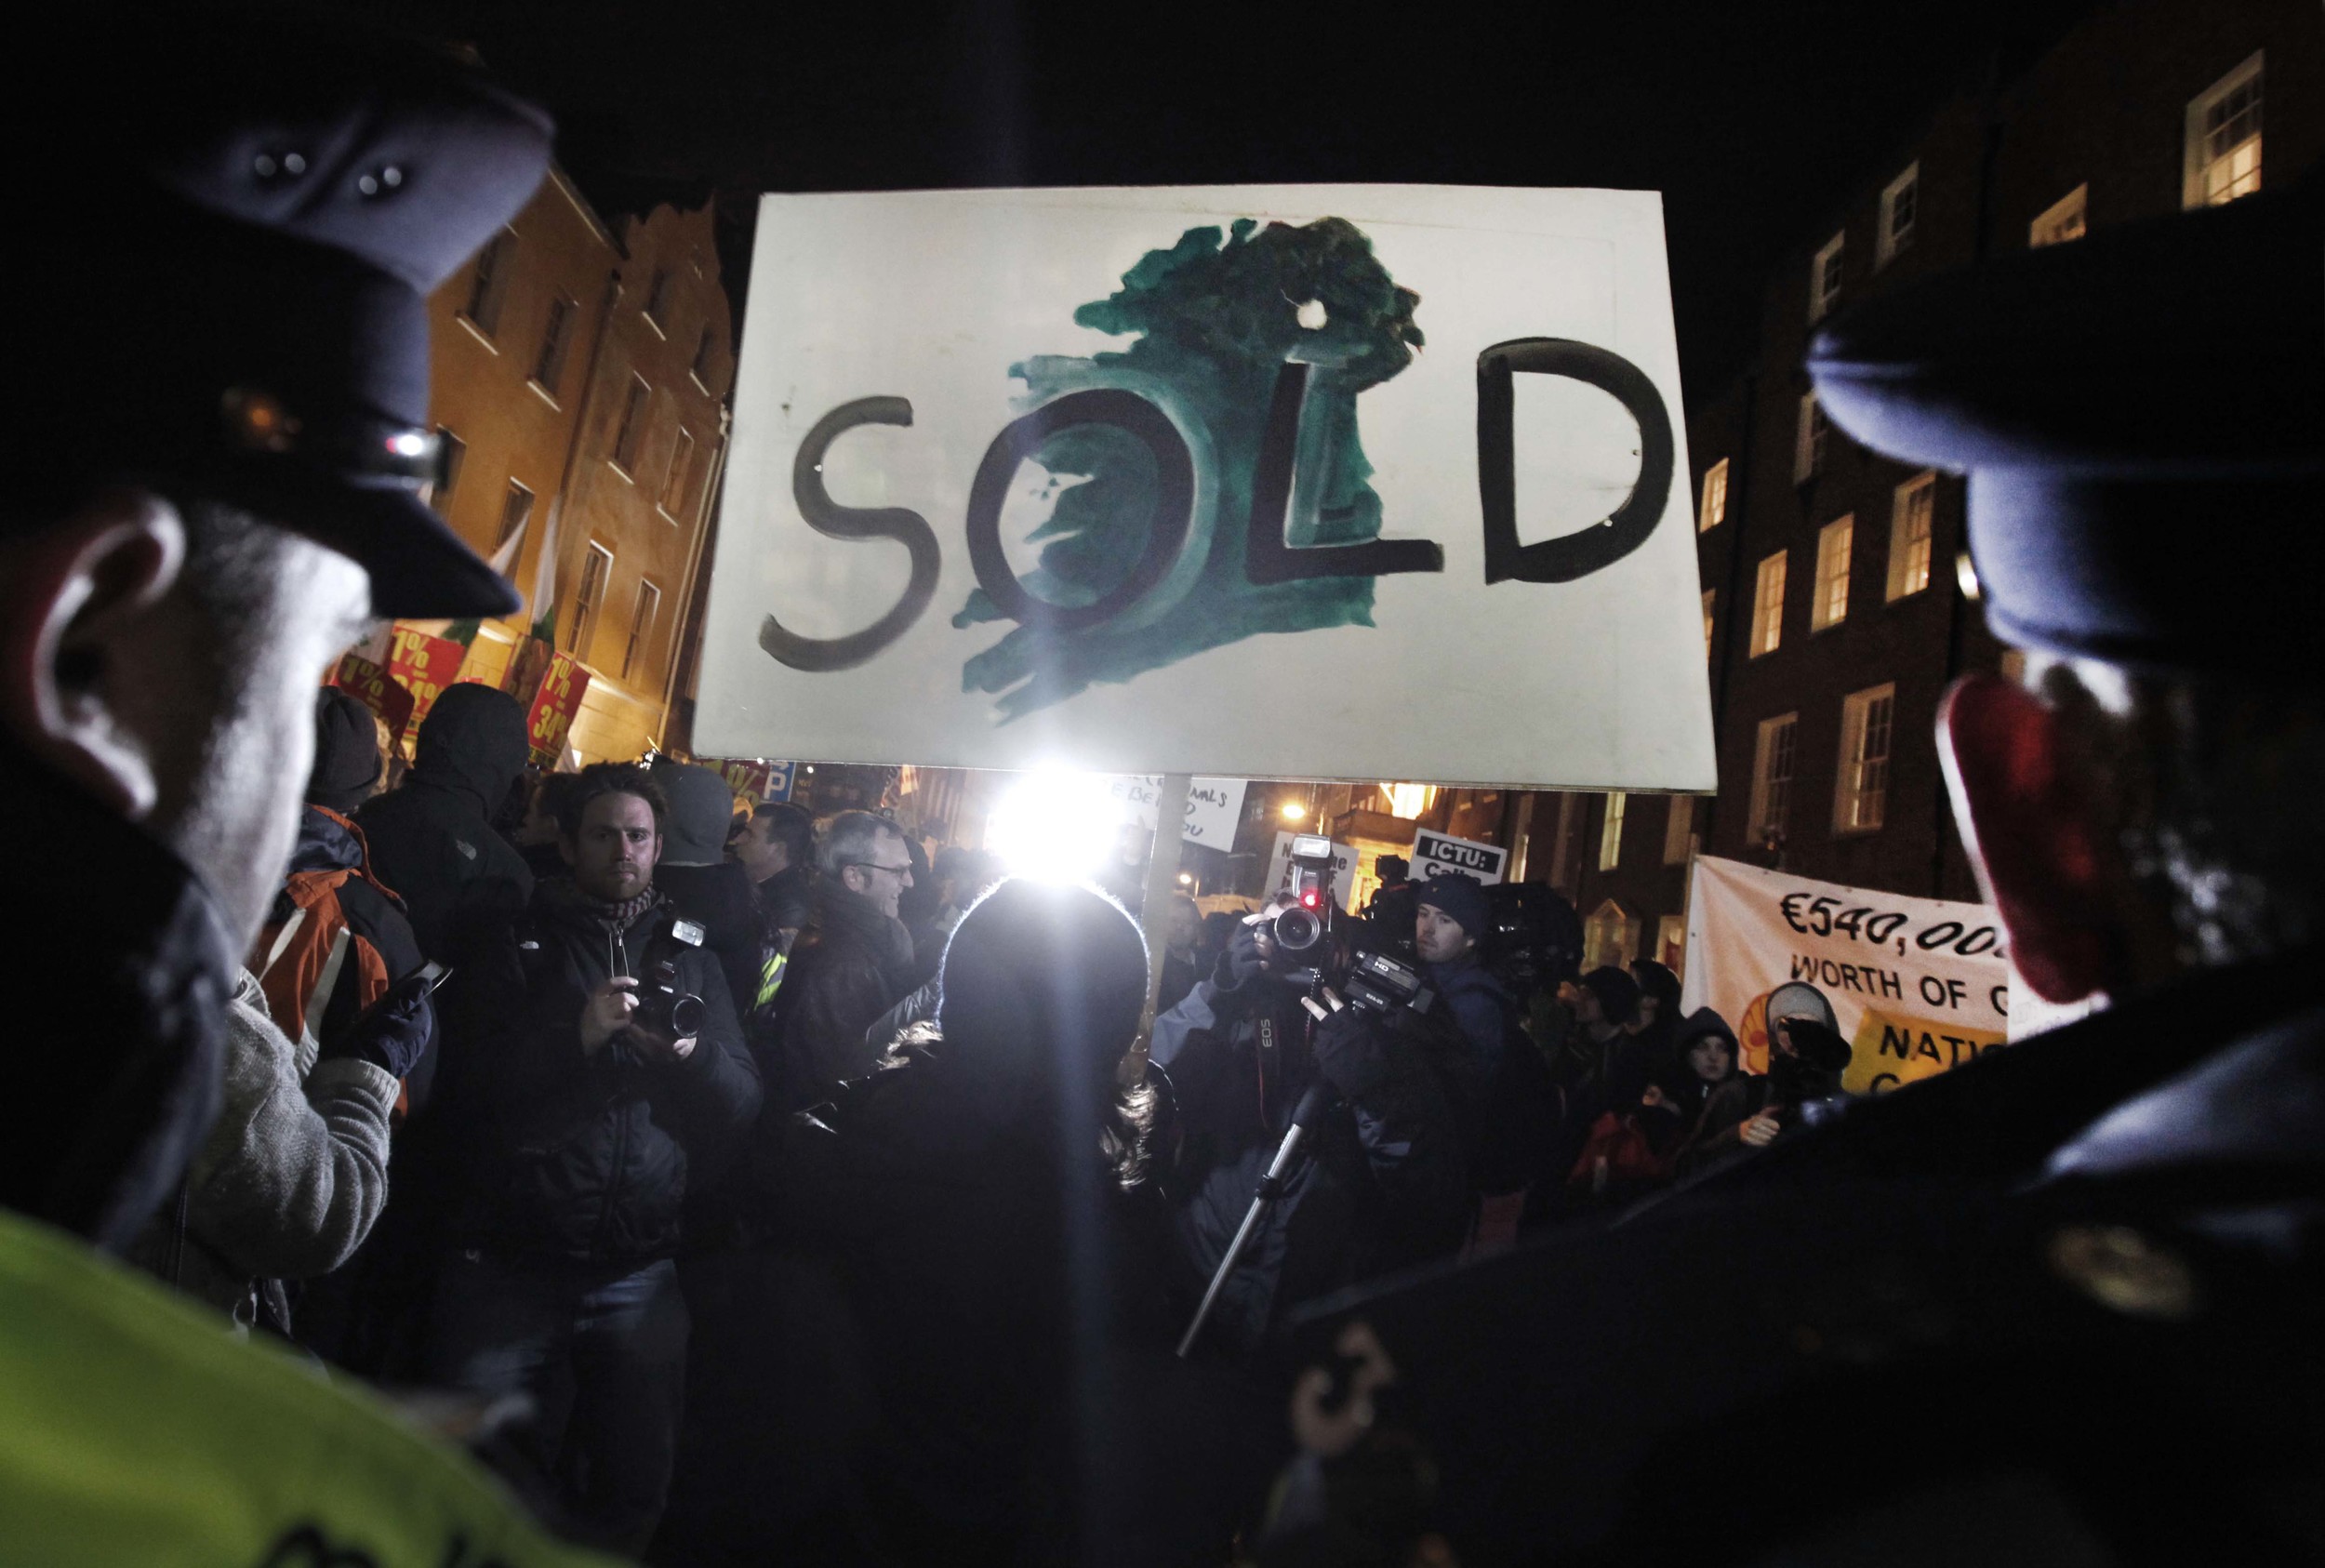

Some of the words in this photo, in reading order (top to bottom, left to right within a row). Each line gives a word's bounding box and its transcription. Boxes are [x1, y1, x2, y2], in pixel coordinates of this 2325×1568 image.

[758, 337, 1675, 672] SOLD
[392, 630, 431, 670] 1%
[340, 655, 385, 697] 1%
[545, 657, 574, 698] 1%
[764, 772, 787, 802] P
[1429, 840, 1486, 869] ICTU:
[1780, 892, 2005, 959] €540,00
[1790, 954, 1903, 1001] WORTH
[1920, 976, 1967, 1009] OF
[1260, 1018, 1272, 1048] EOS
